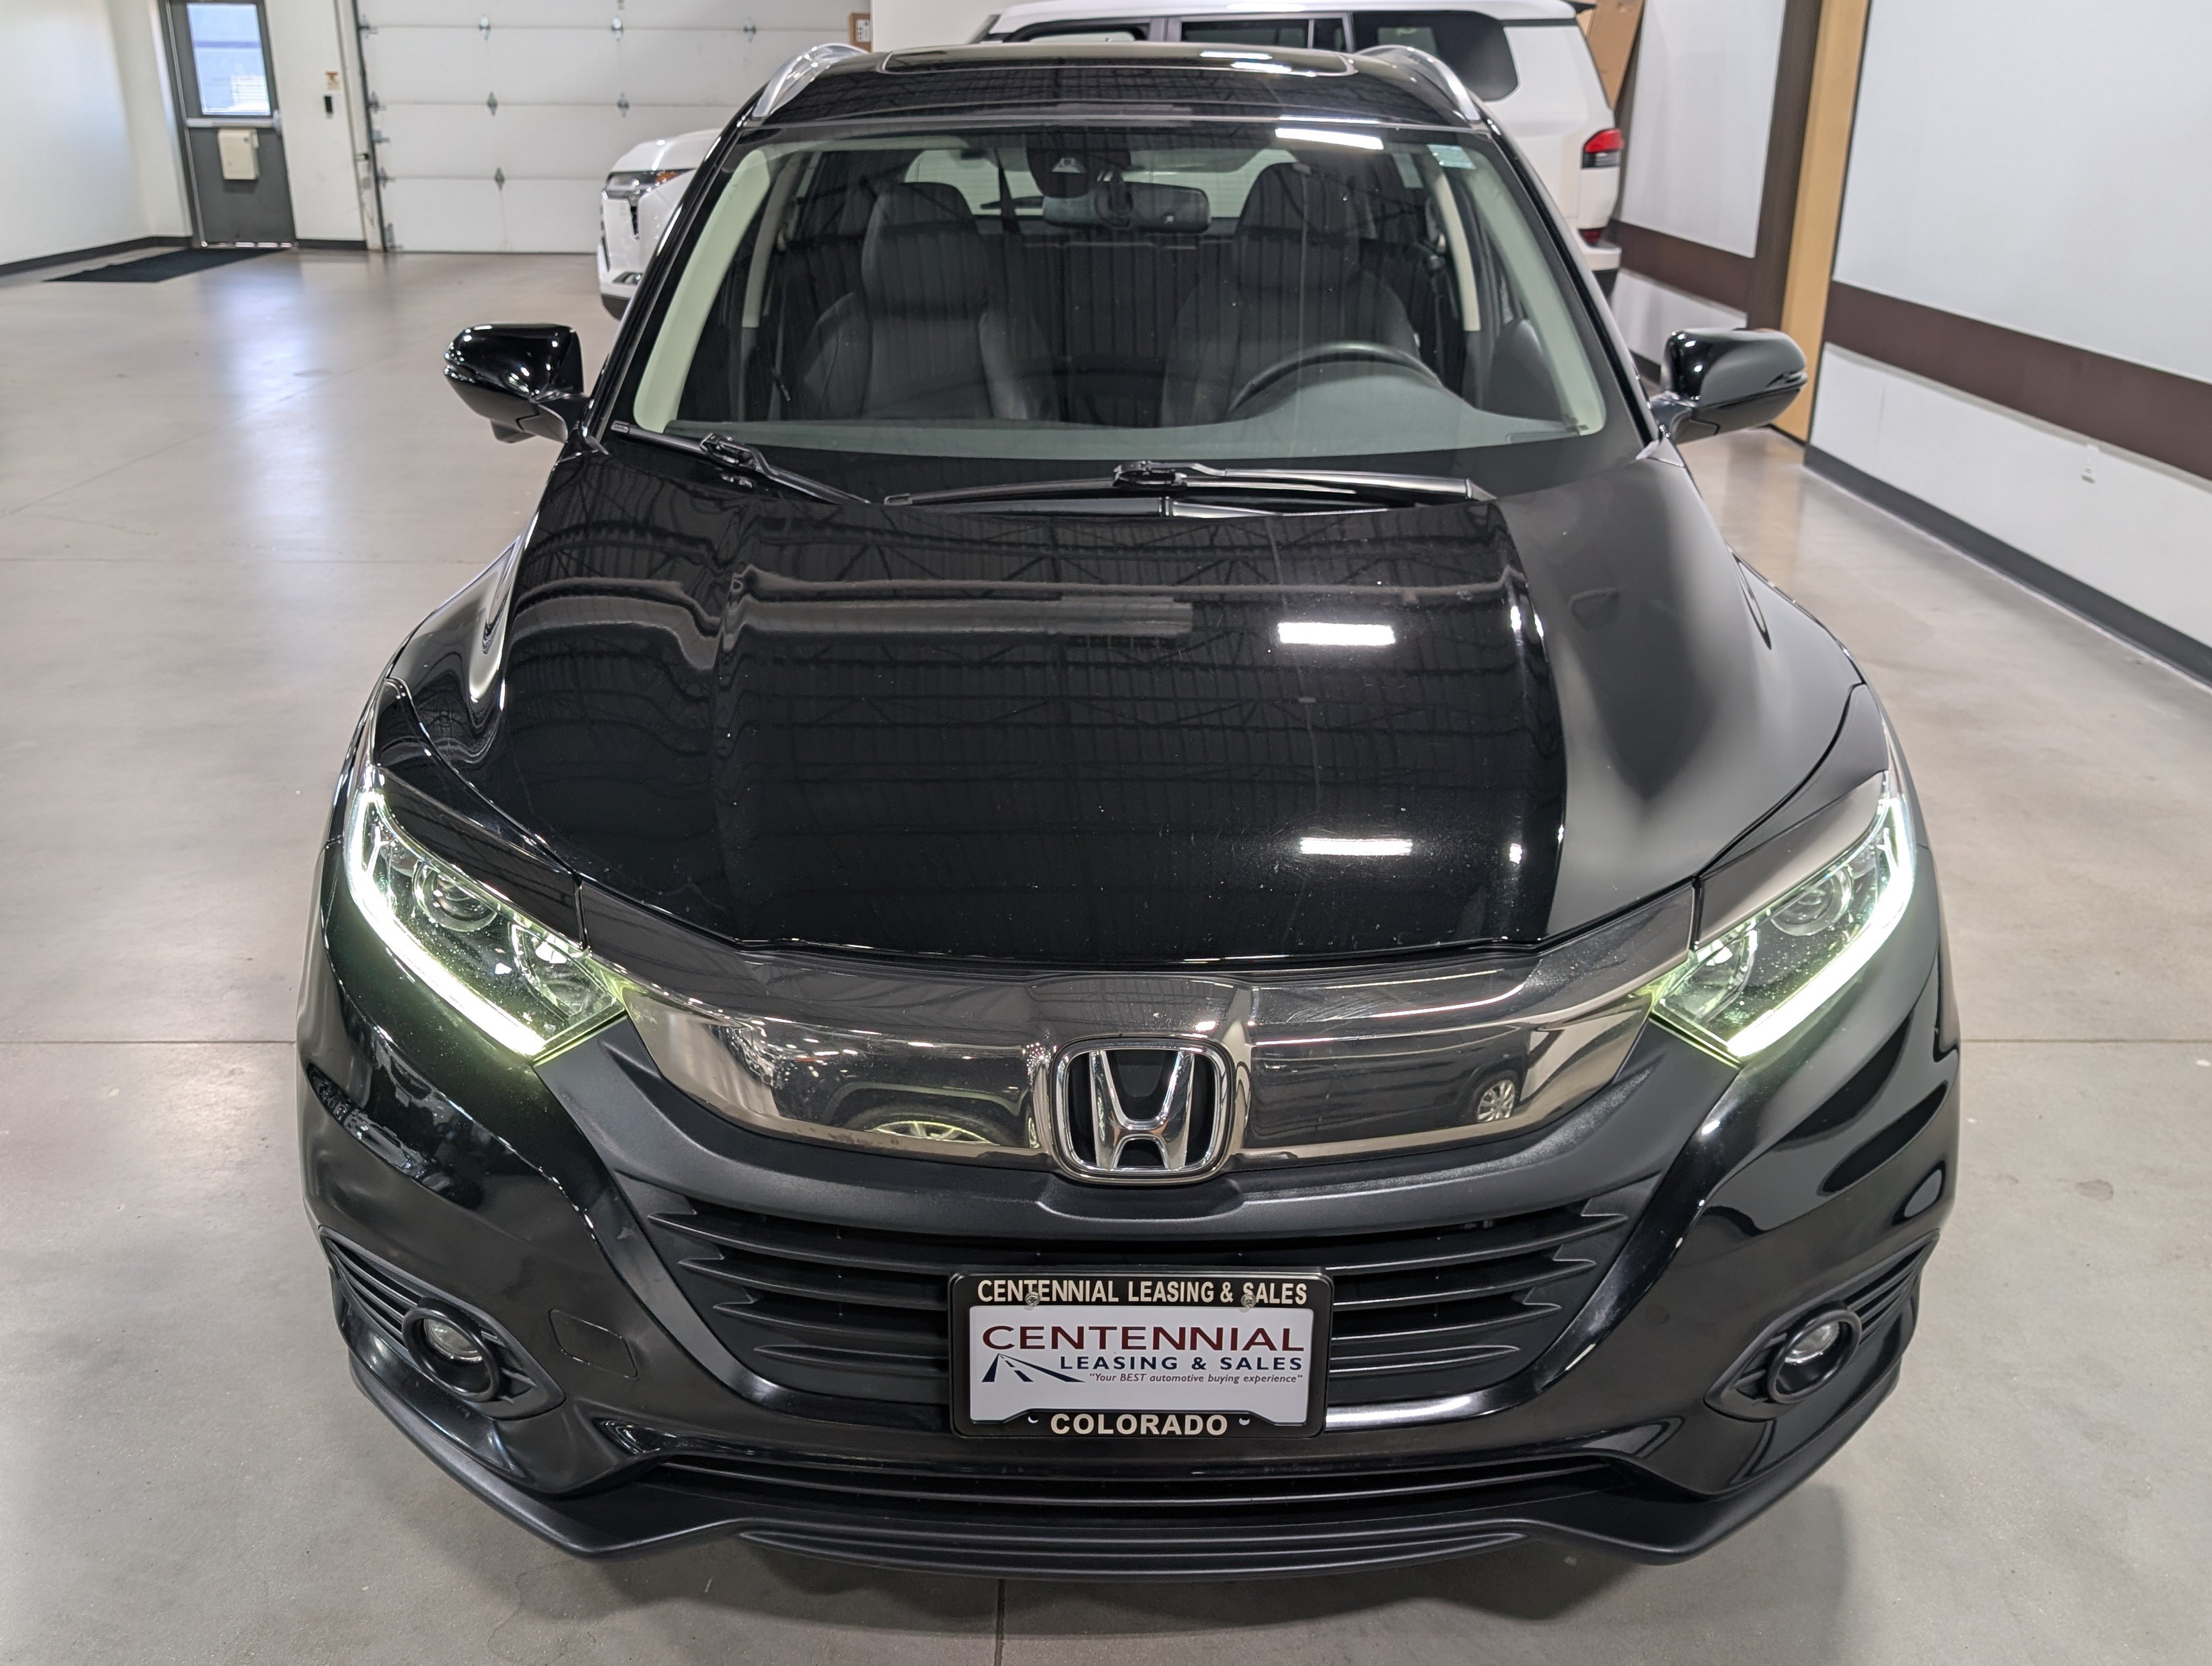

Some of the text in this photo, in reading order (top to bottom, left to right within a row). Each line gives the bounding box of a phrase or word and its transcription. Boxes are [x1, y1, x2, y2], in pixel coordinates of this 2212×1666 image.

[978, 1280, 1308, 1305] CENTENNIAL LEASING & SALES
[982, 1325, 1304, 1351] CENTENNIAL
[1060, 1356, 1302, 1370] LEASING & SALES
[1120, 1373, 1147, 1382] BEST
[1149, 1374, 1204, 1382] automotive
[1207, 1374, 1240, 1384] buying
[1051, 1413, 1228, 1436] COLORADO
